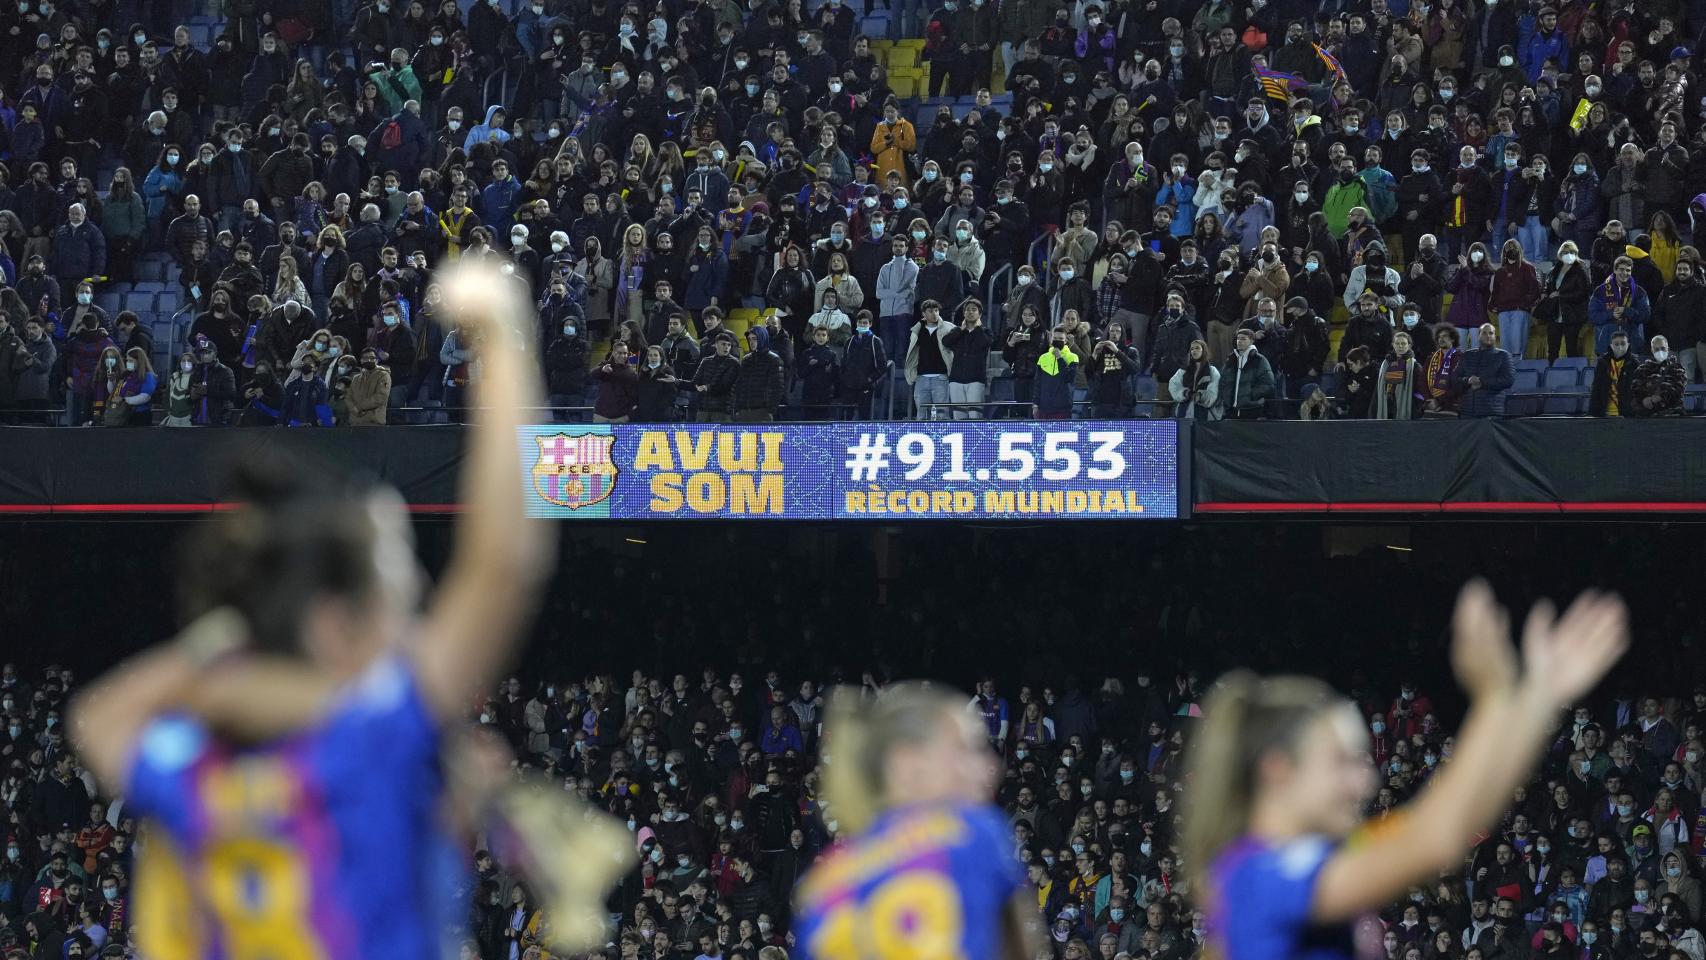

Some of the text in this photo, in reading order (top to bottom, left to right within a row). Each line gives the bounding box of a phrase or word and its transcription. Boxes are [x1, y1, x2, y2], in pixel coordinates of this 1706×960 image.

[634, 431, 784, 471] AVUI
[845, 432, 1126, 481] #91.553
[650, 472, 785, 514] SOM
[845, 484, 1144, 513] RÈCORD MUNDIAL
